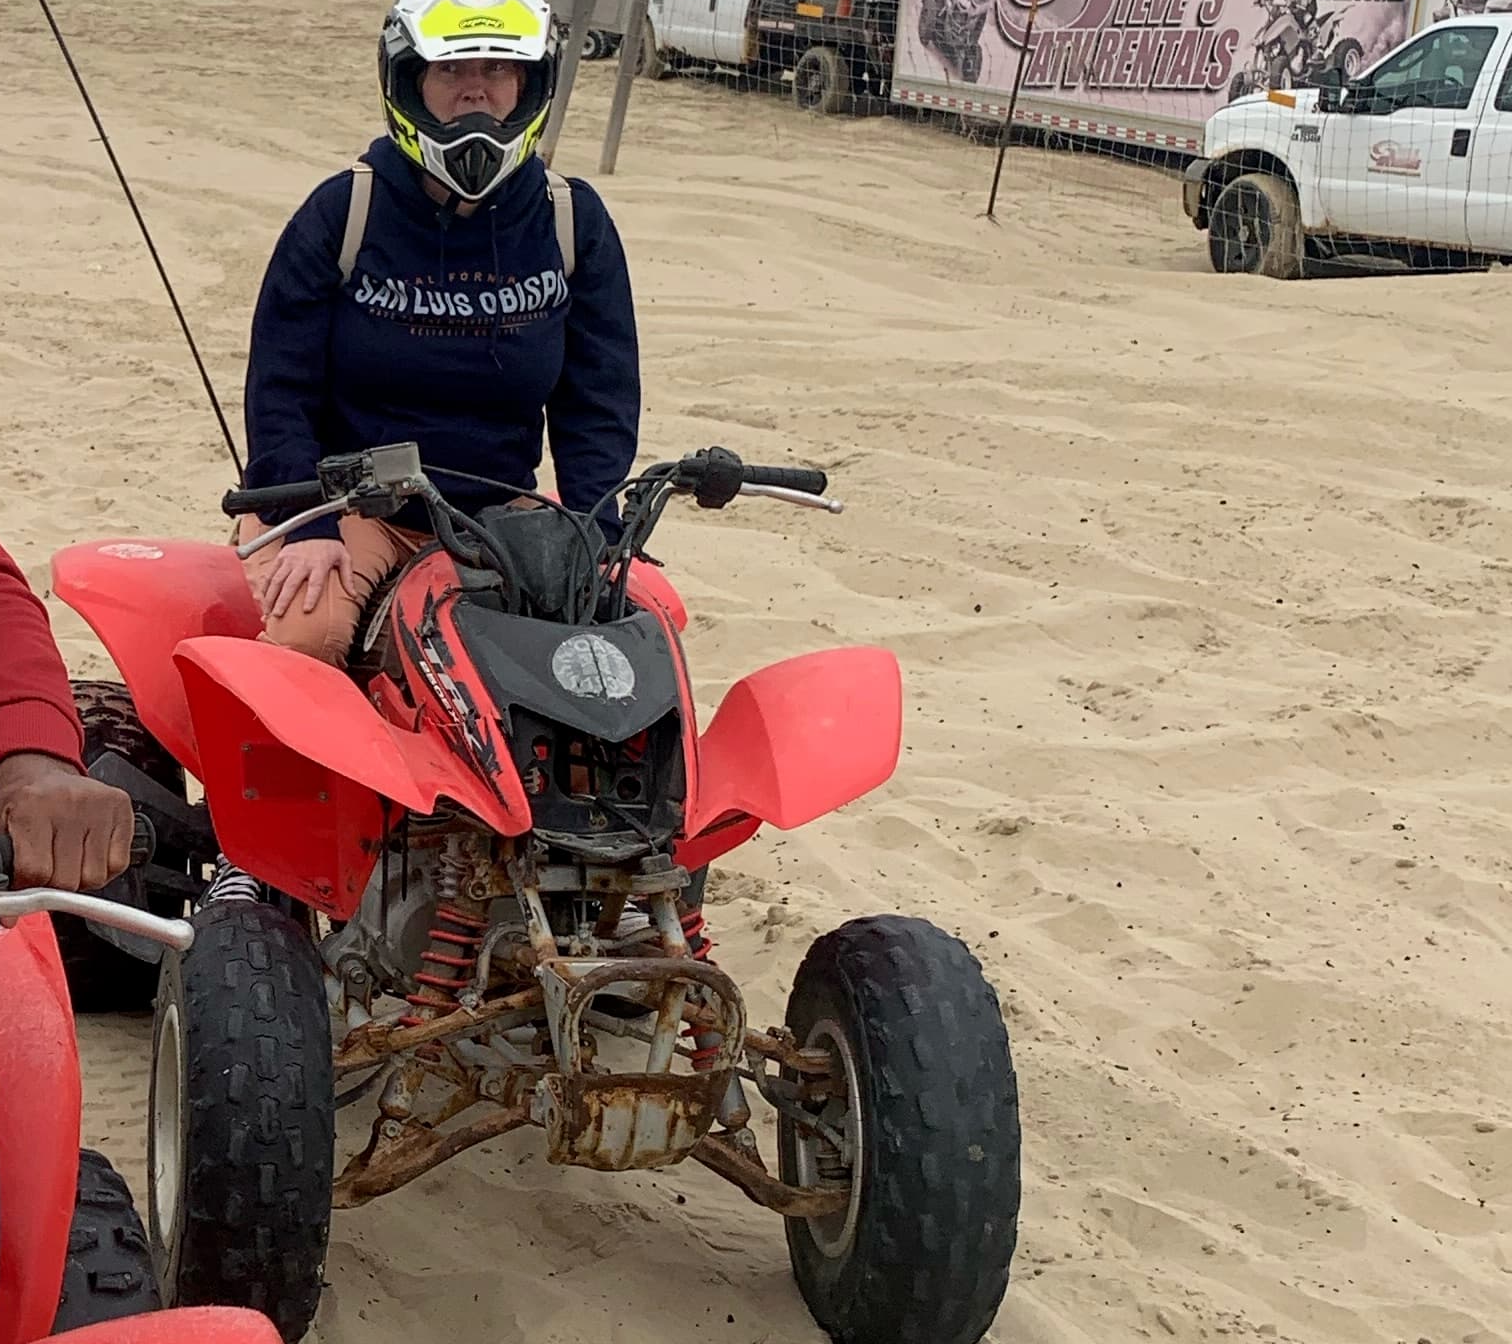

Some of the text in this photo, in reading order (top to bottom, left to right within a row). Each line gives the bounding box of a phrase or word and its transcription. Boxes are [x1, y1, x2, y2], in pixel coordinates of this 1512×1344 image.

[1024, 28, 1240, 90] ATV RENTALS
[354, 269, 569, 317] SAN LUIS OBISPO
